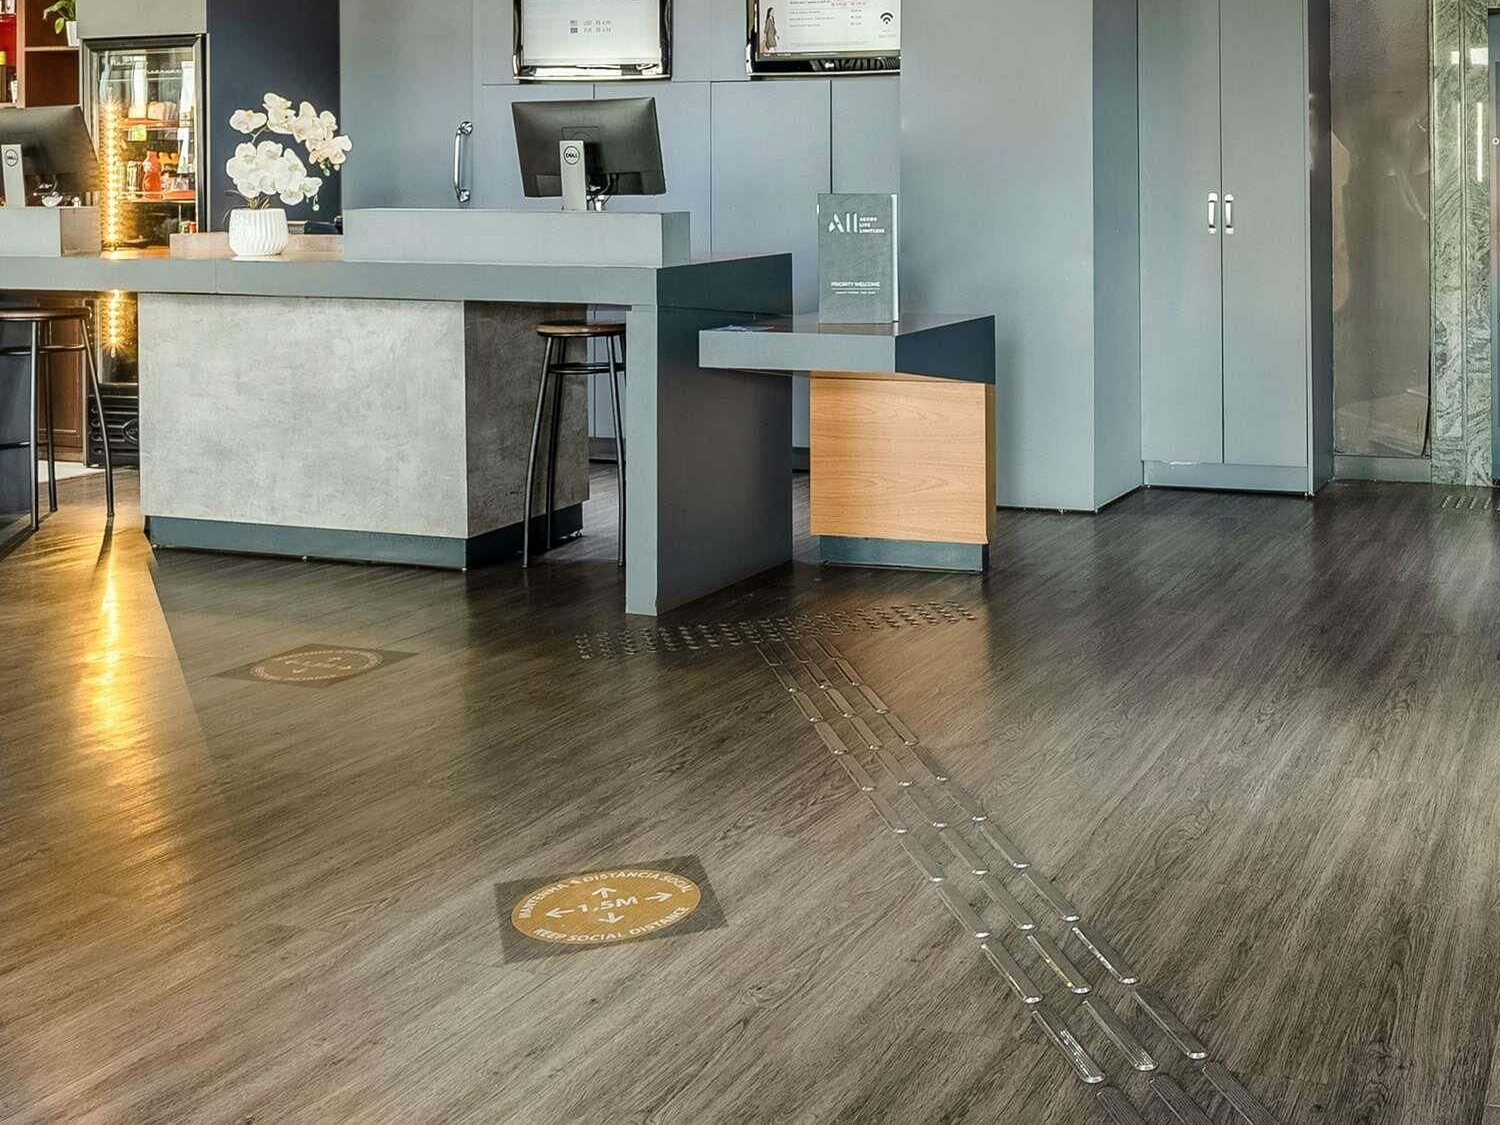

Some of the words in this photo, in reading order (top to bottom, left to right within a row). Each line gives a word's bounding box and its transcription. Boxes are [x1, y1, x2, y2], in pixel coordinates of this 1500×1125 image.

[1492, 137, 1500, 146] O
[583, 871, 660, 884] DISTÂNCIA
[577, 895, 639, 913] 1.5M
[532, 928, 566, 941] KEEP
[566, 932, 626, 942] SOCIAL
[629, 906, 690, 937] DISTANCE
